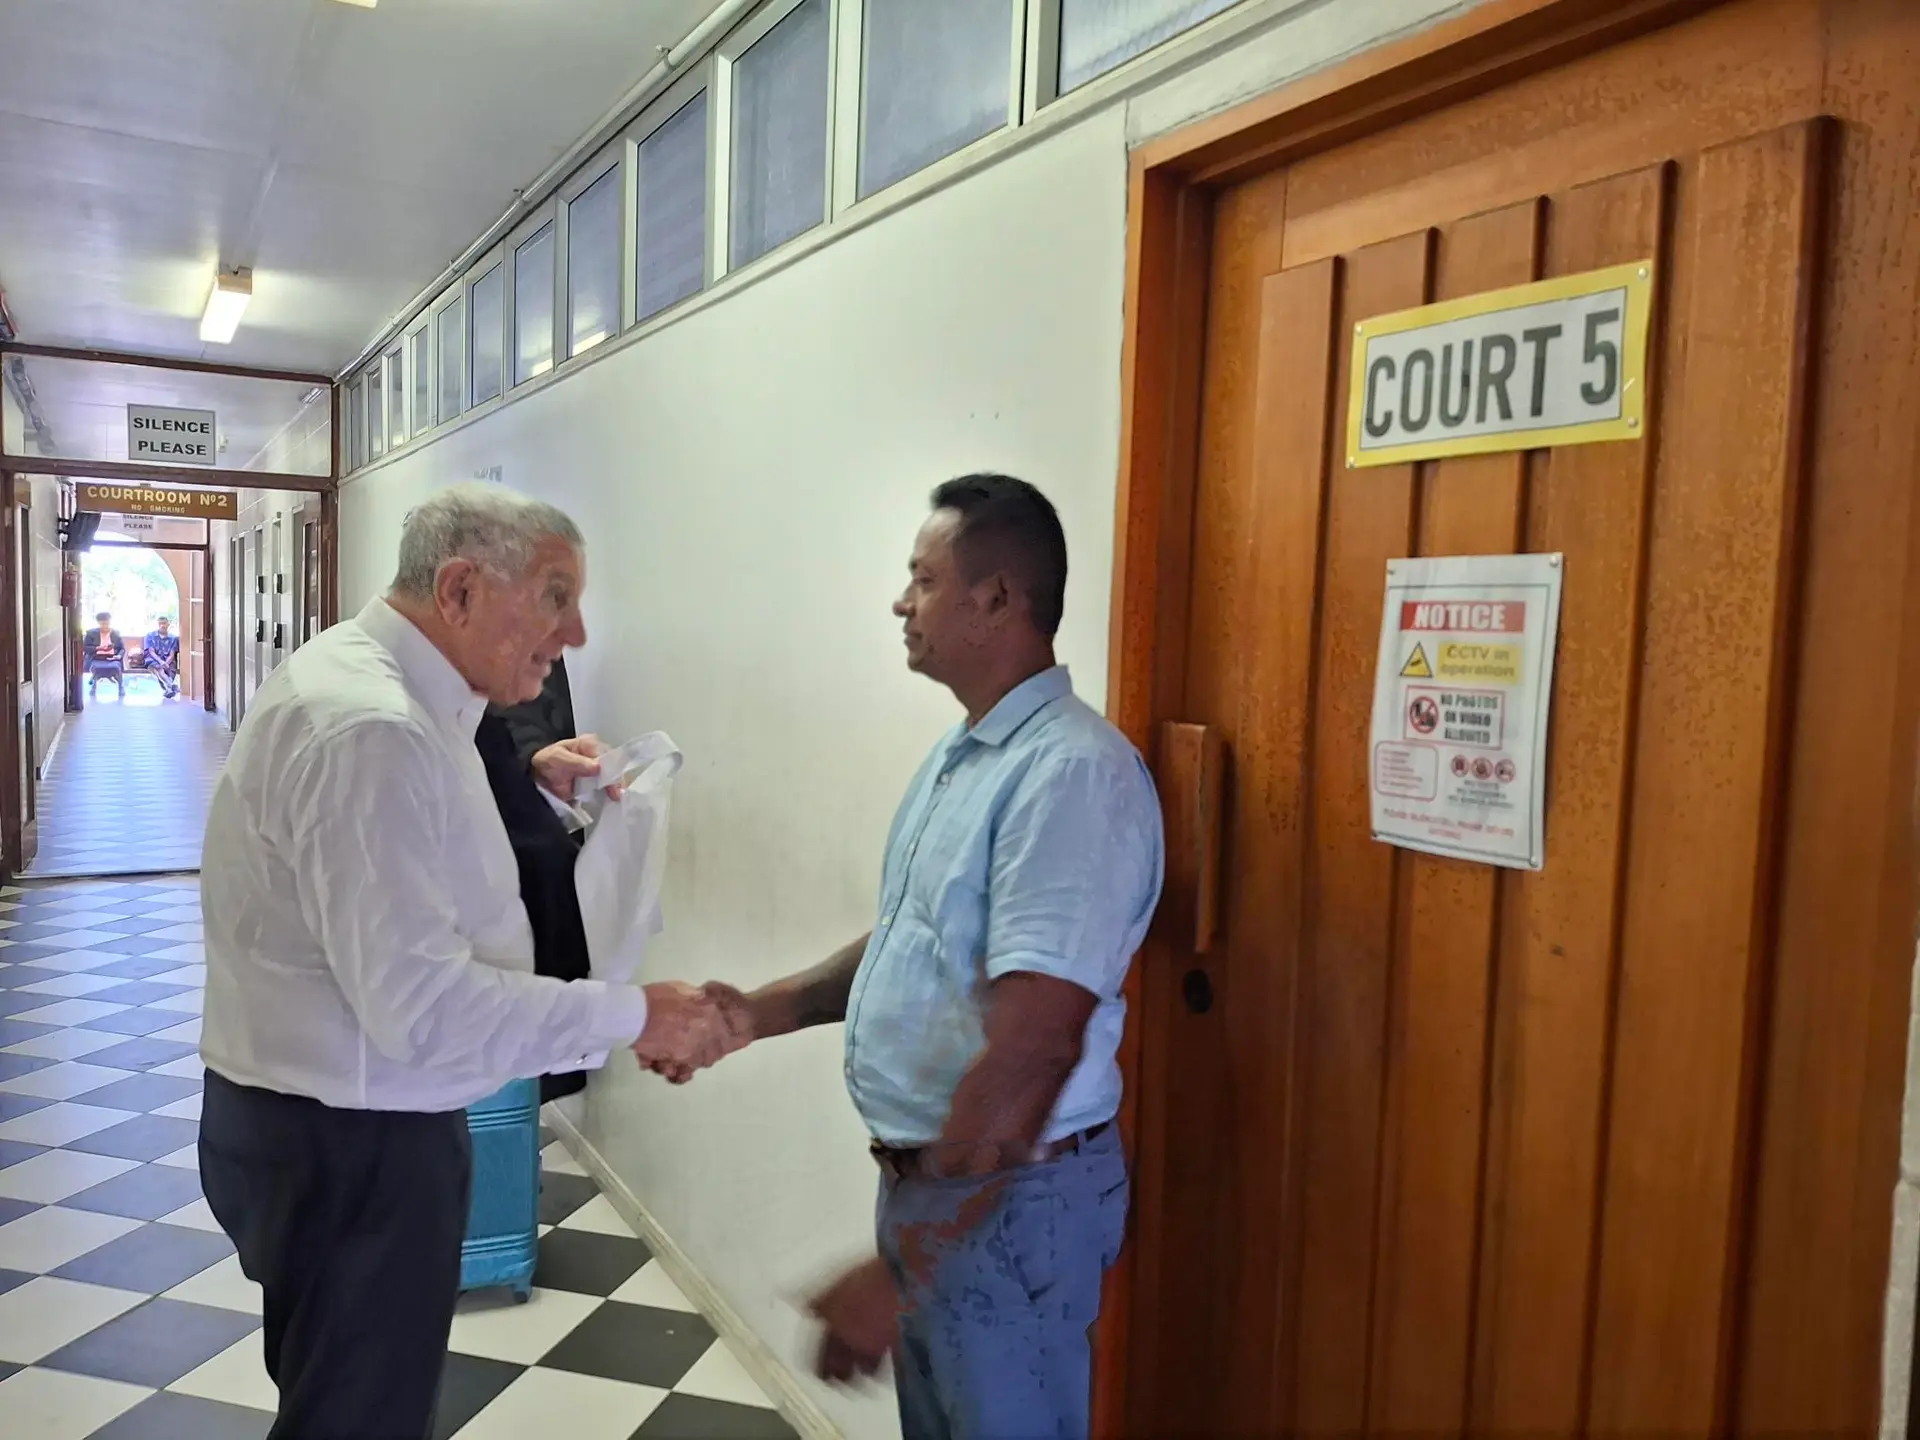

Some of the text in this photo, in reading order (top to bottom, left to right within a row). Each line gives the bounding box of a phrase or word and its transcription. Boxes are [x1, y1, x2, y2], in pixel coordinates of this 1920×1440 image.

[1365, 307, 1620, 438] COURT 5
[133, 417, 210, 434] SILENCE
[138, 440, 207, 456] PLEASE
[87, 486, 191, 505] COURTROOM
[131, 503, 185, 514] NO SMOKING
[1414, 603, 1506, 630] NOTICE
[1446, 644, 1490, 660] CCTV
[1441, 663, 1515, 677] operation
